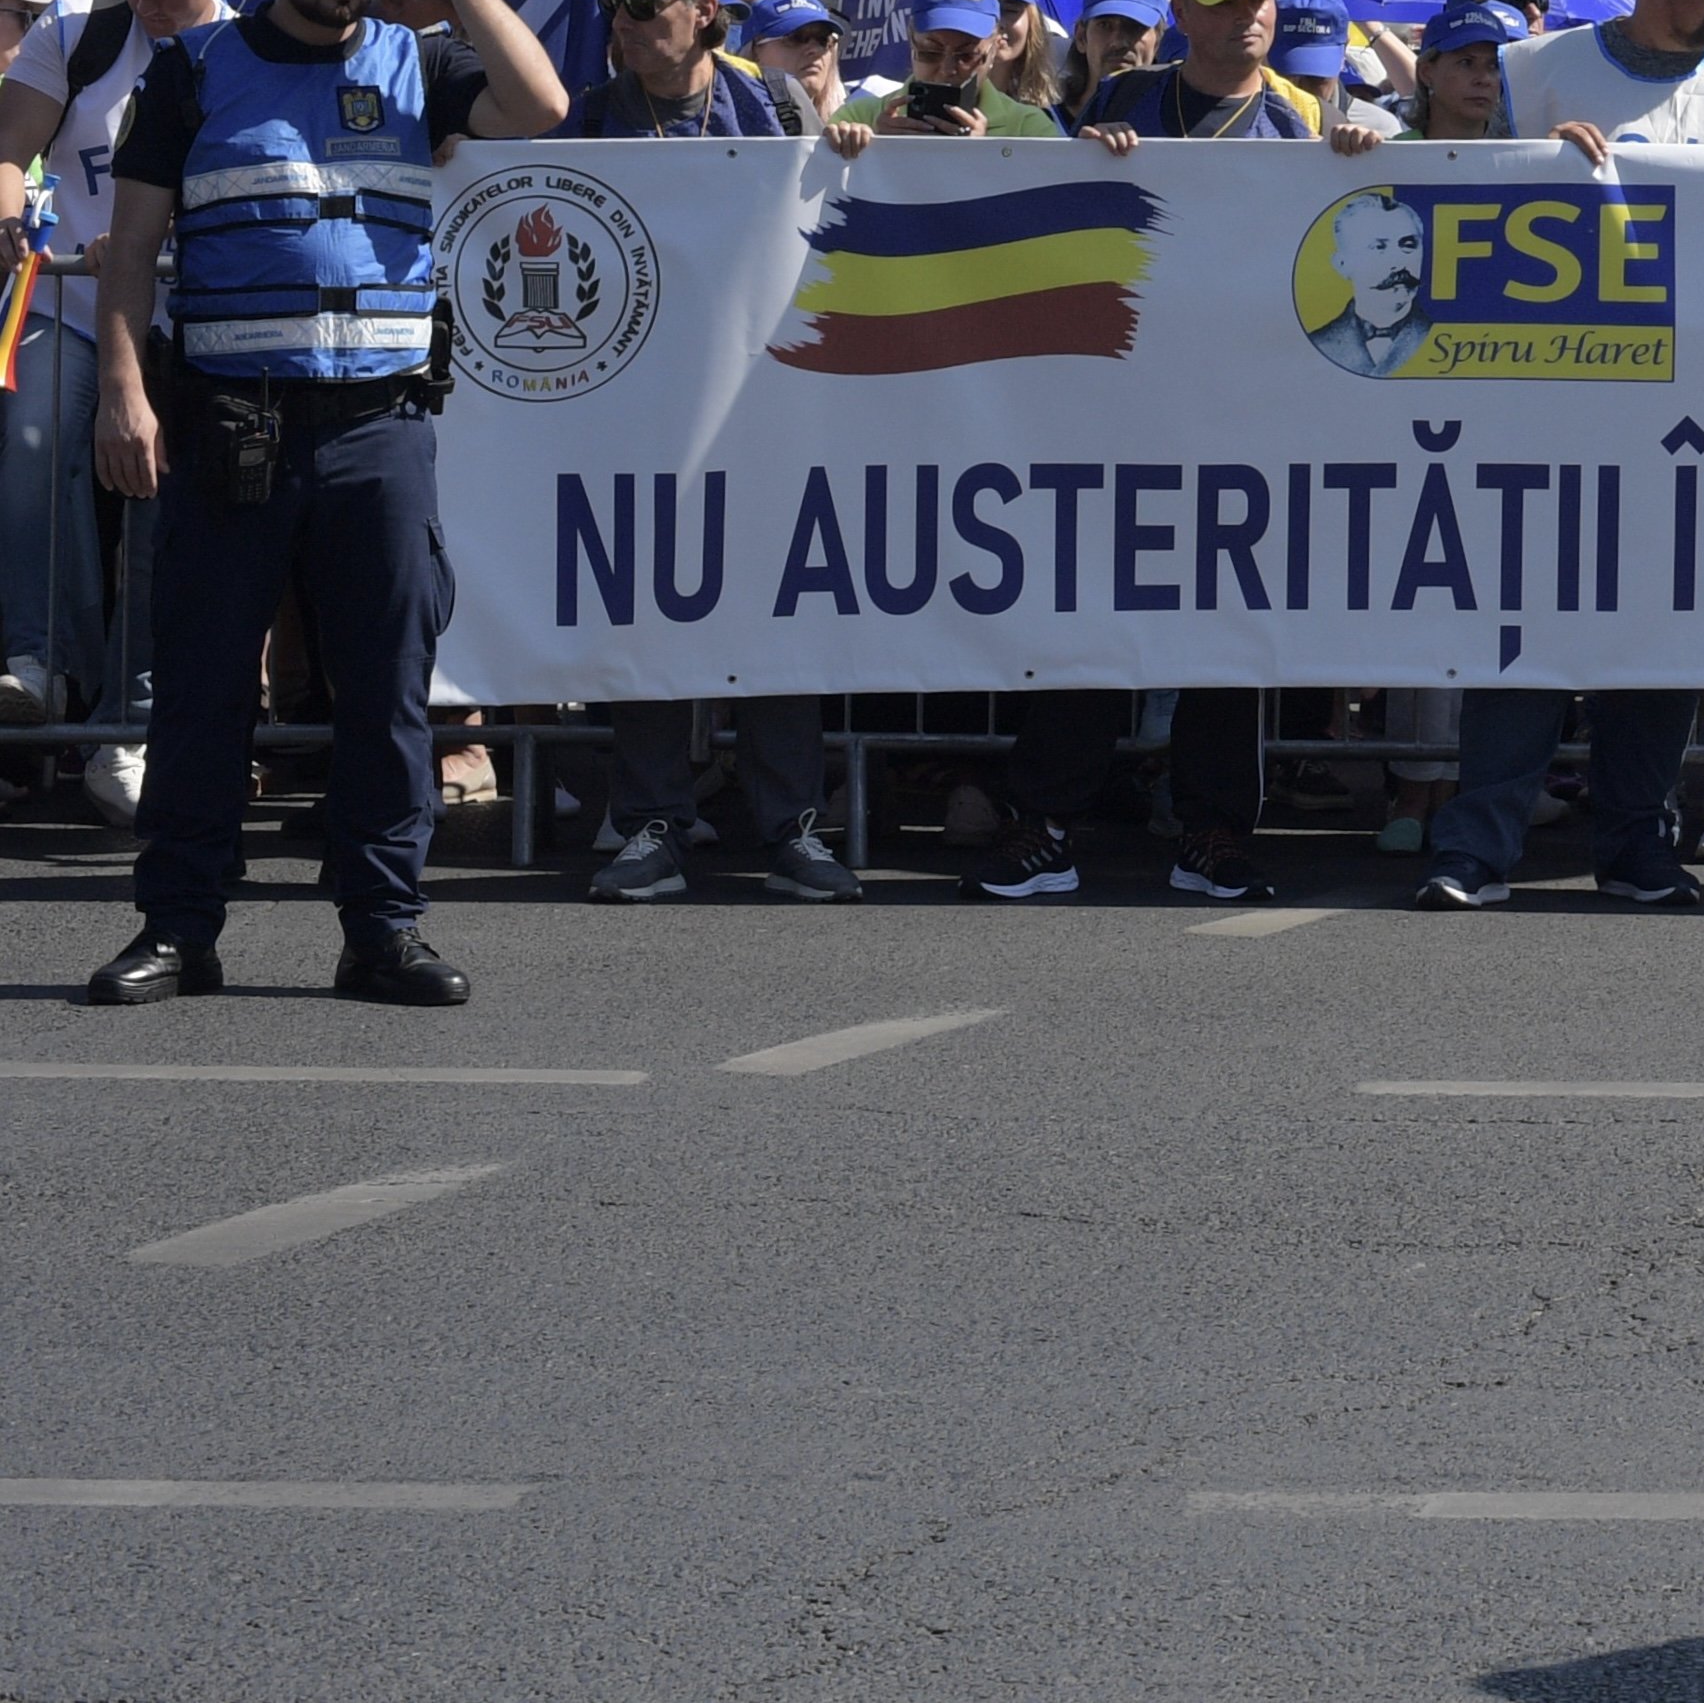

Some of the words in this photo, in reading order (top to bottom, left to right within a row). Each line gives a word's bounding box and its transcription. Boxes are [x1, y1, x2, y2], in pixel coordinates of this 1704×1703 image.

[439, 175, 534, 254] SINDICATELOR
[545, 175, 608, 209] LIBERE
[609, 208, 637, 240] DIN
[1430, 200, 1669, 303] FSE
[1427, 331, 1537, 375] Spiru
[1543, 330, 1669, 366] Haret
[556, 471, 728, 627] NU
[771, 419, 1622, 675] AUSTERITĂȚII
